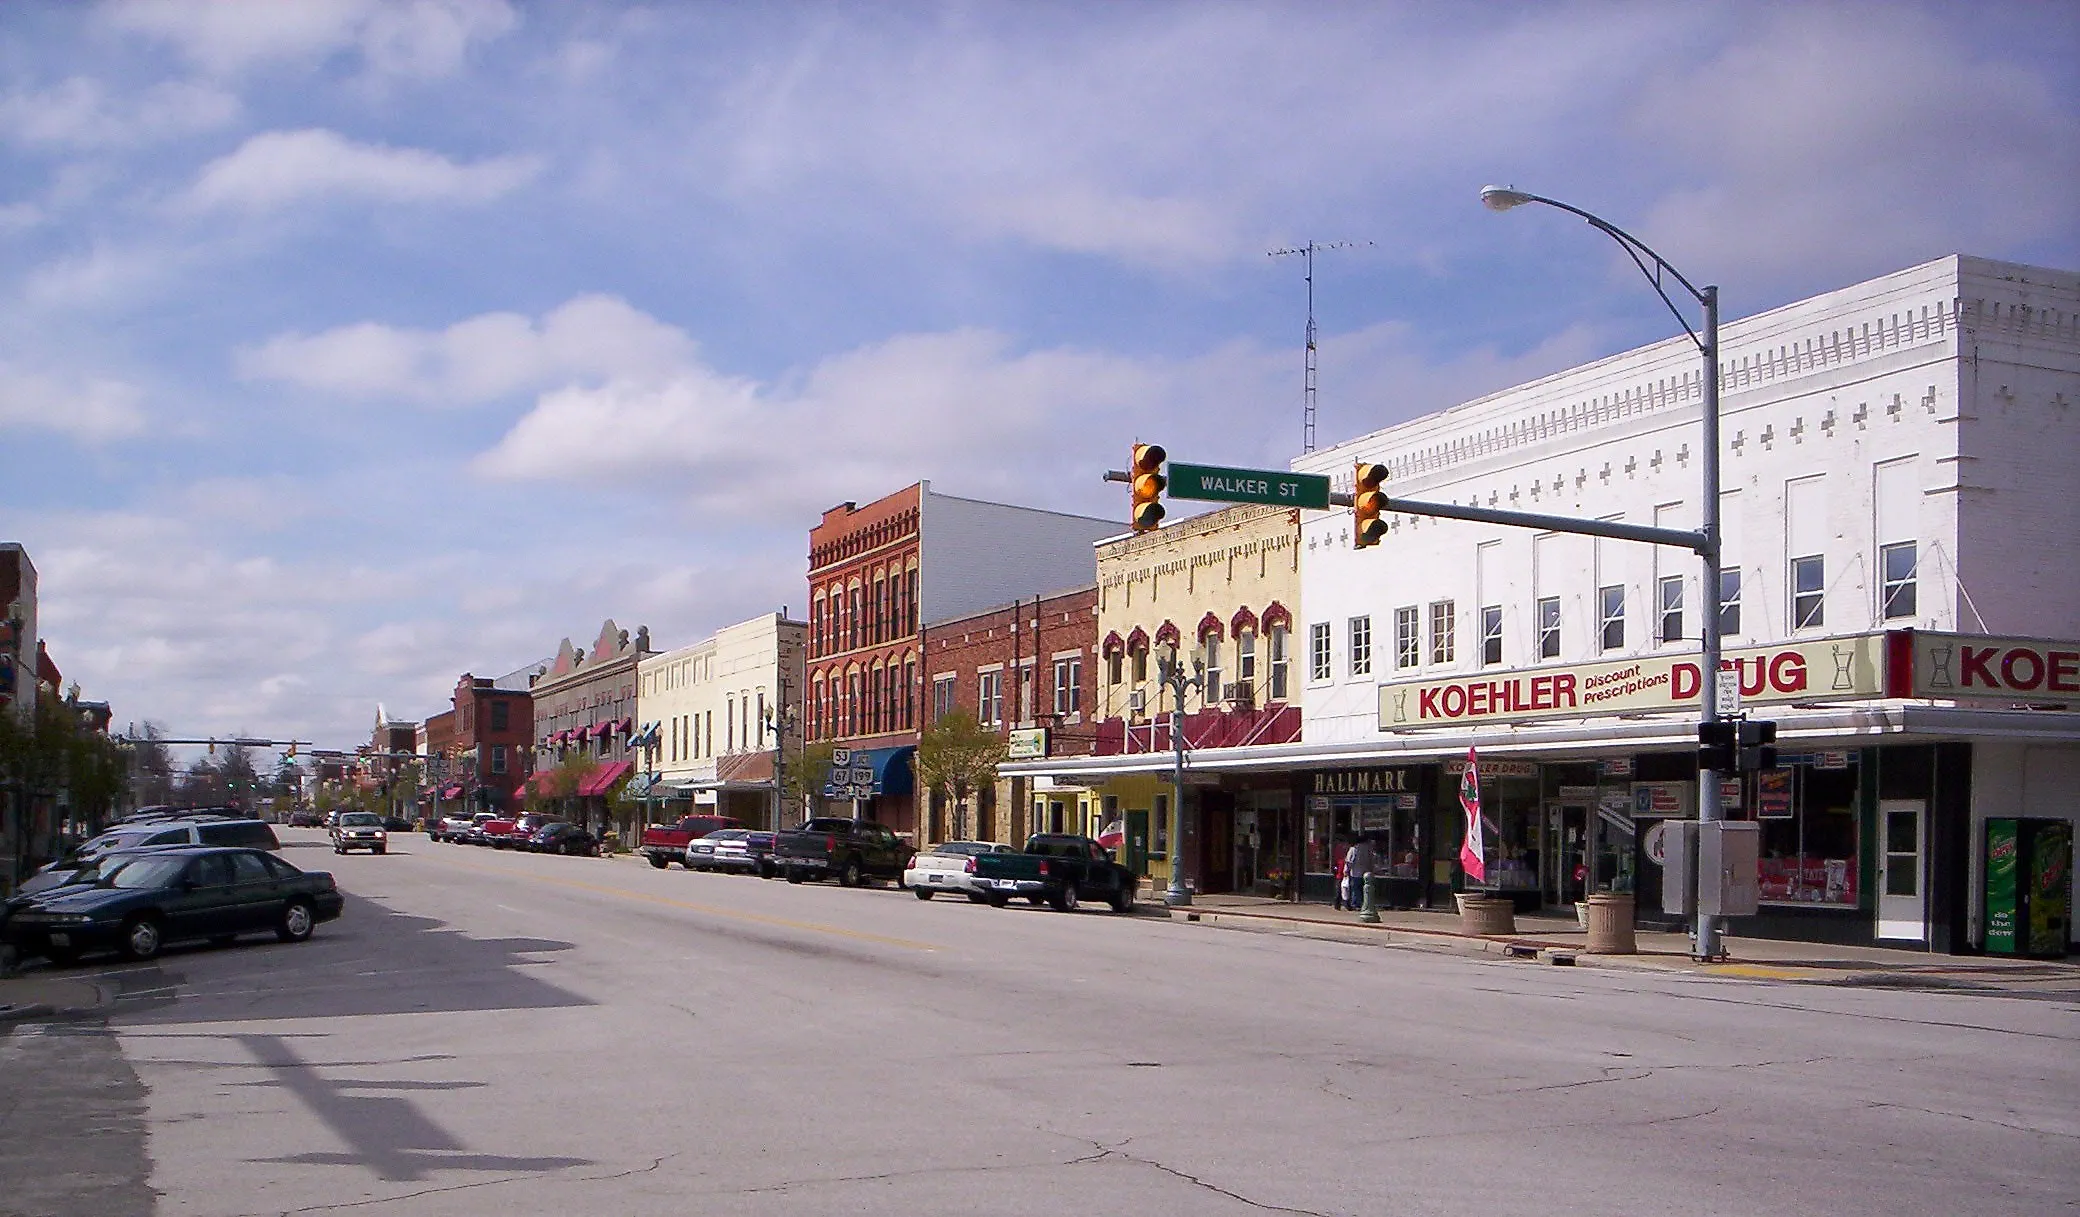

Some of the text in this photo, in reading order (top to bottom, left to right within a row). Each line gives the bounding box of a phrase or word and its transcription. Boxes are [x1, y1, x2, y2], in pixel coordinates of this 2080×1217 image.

[1201, 476, 1299, 497] WALKER ST
[1420, 673, 1577, 719] KOEHLER
[1671, 651, 1808, 701] DUG
[1583, 673, 1669, 704] Prescriptions
[1585, 663, 1641, 690] Discount
[1448, 763, 1530, 774] KOLER DRUG
[1315, 770, 1407, 793] HALLMARK
